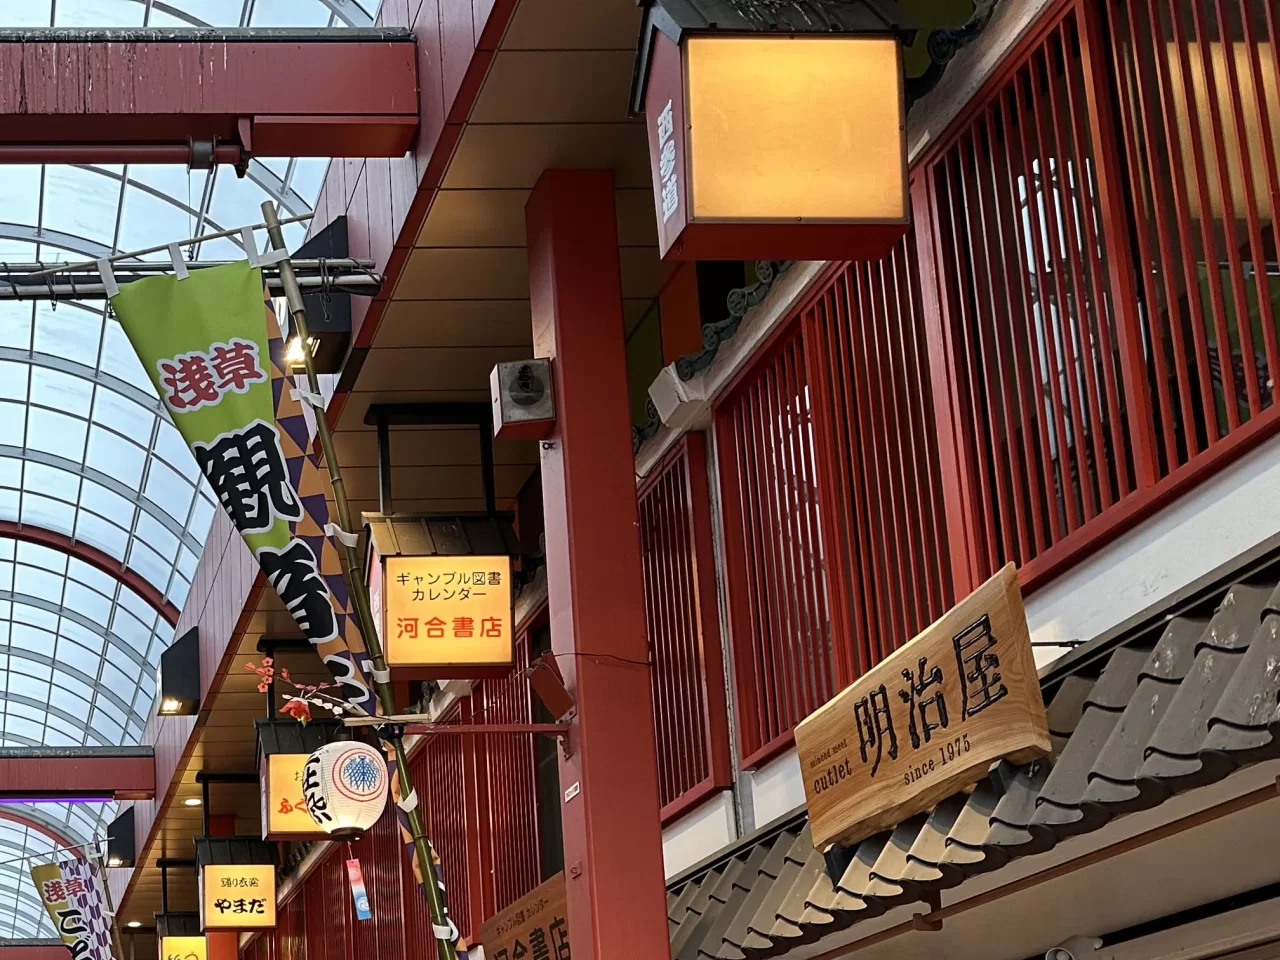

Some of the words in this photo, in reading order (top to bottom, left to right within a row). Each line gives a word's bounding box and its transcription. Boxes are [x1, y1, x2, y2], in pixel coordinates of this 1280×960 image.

[161, 342, 262, 409] 浅草
[397, 571, 501, 586] ギャンブル図書
[412, 587, 486, 602] カレンダー
[397, 616, 502, 639] 河合書店
[853, 613, 1009, 778] 明治屋
[904, 756, 936, 785] since
[941, 732, 971, 767] 1975
[814, 758, 852, 794] cutlet
[43, 878, 86, 903] 浅草
[214, 898, 266, 914] やまだ
